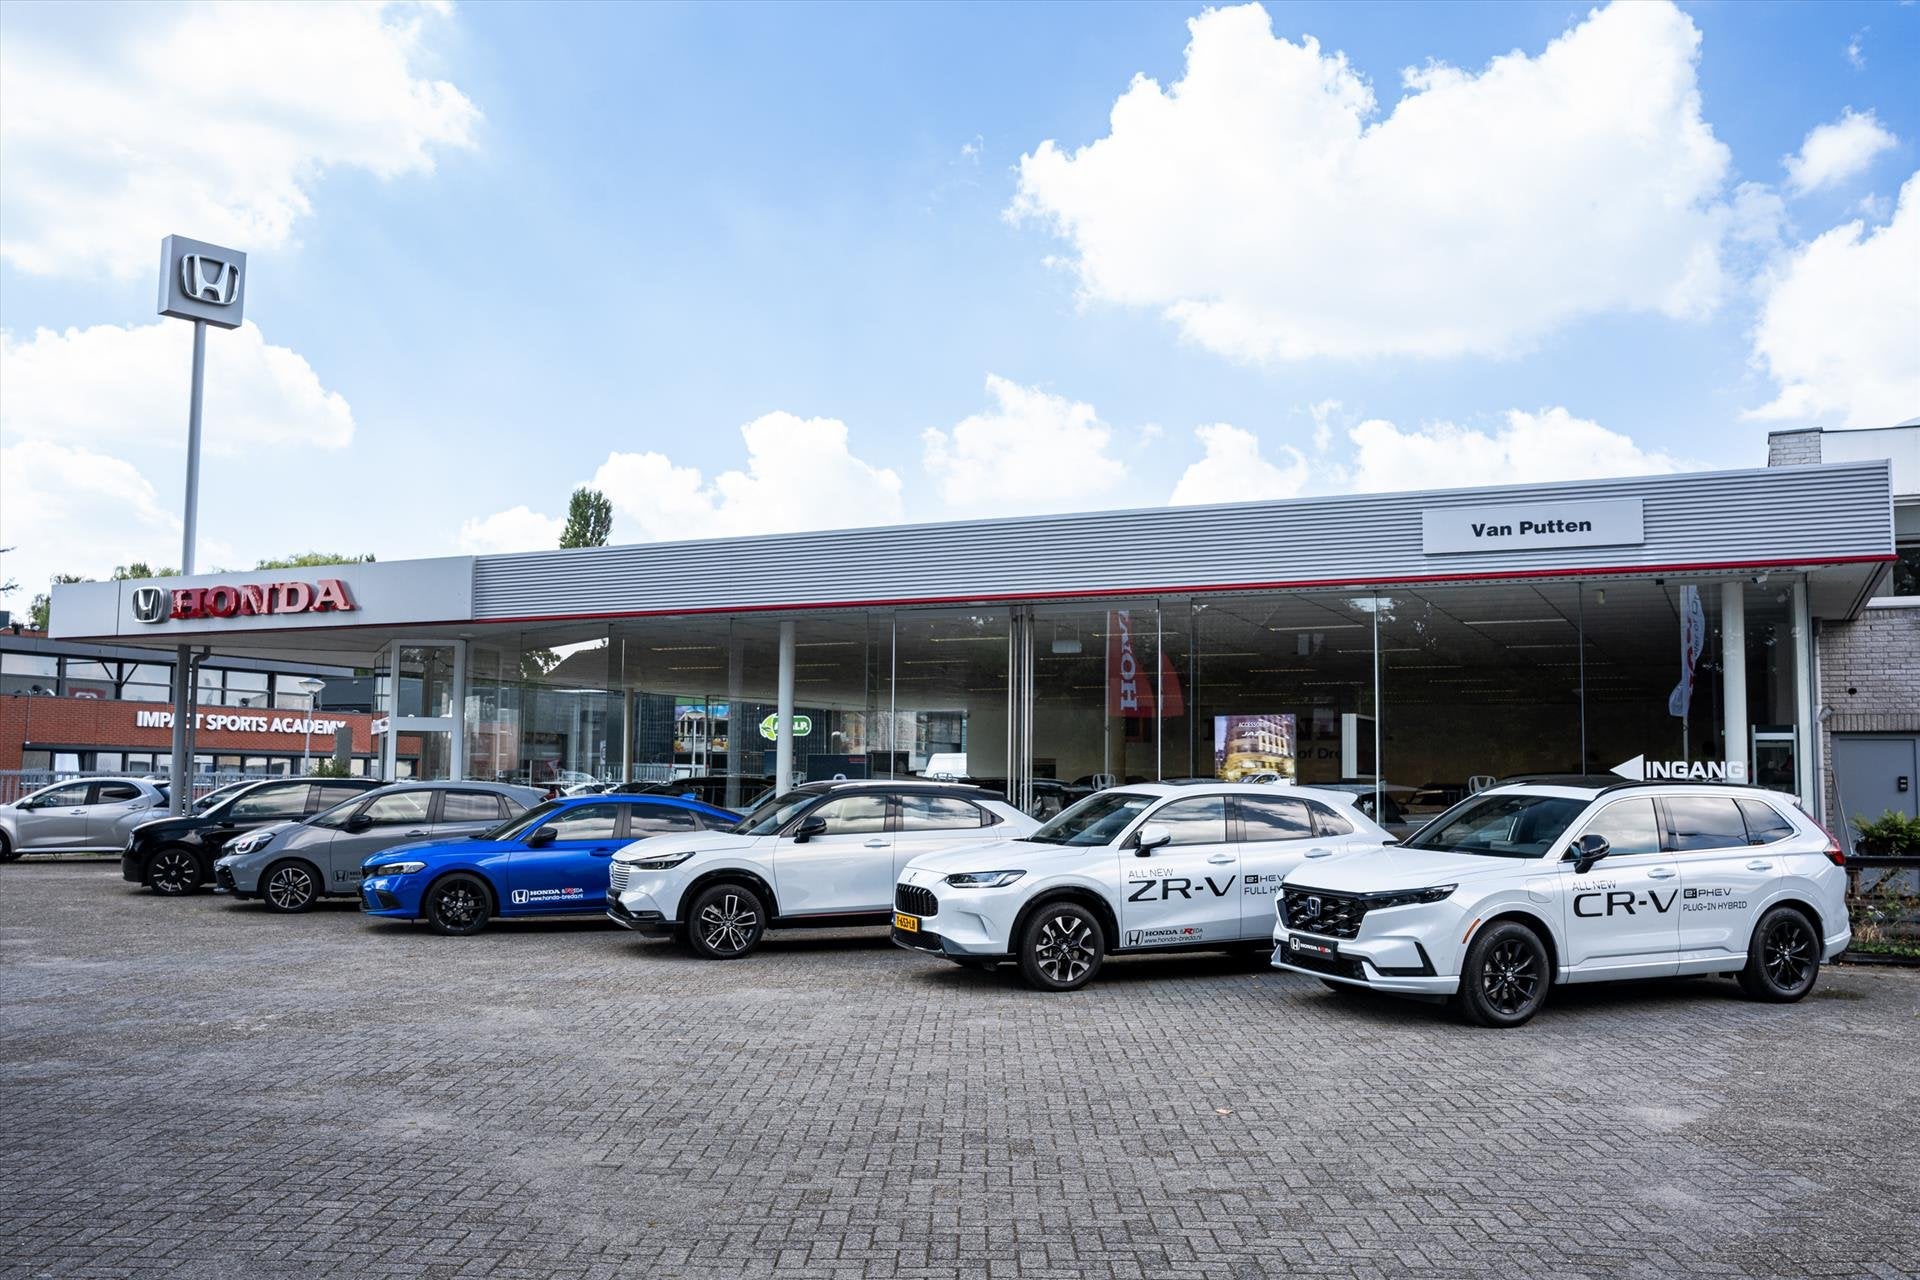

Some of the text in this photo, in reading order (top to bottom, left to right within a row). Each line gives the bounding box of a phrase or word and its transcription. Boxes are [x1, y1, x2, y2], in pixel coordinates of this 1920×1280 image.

[1471, 519, 1592, 537] Van Putten
[169, 579, 355, 619] HONDA
[136, 711, 205, 729] IMPAT
[206, 714, 268, 732] SPORTS
[1646, 761, 1744, 778] INGANG
[1128, 868, 1174, 879] ALL NEW
[1128, 875, 1236, 902] ZR-V
[1244, 886, 1268, 895] FULL
[1572, 880, 1616, 891] ALL NEW
[1573, 889, 1678, 918] CR-V
[1683, 901, 1747, 911] PLUG-IN HYBRID
[1145, 929, 1178, 937] HONDA
